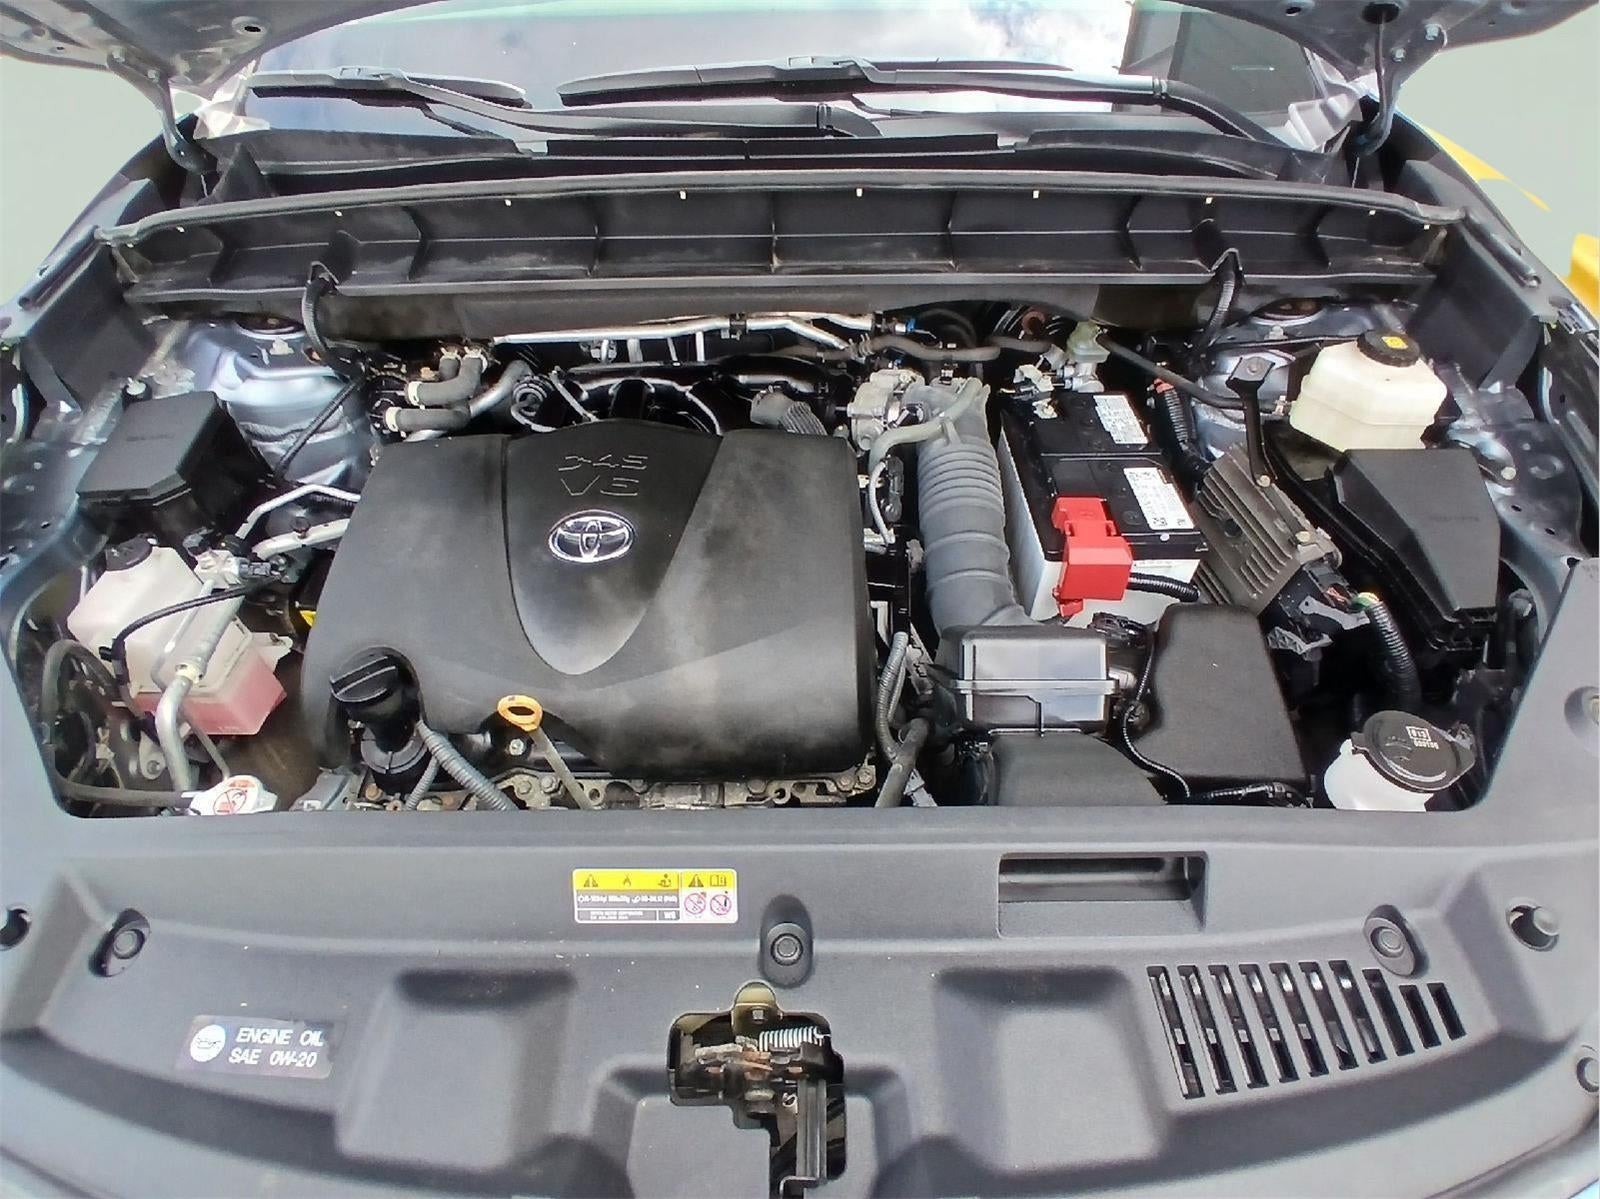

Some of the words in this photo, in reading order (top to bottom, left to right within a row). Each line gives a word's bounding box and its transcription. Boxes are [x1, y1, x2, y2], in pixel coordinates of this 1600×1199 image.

[235, 1027, 294, 1045] ENGINE
[299, 1030, 325, 1047] OIL
[228, 1047, 262, 1065] SAE
[269, 1050, 318, 1068] 0W-20
